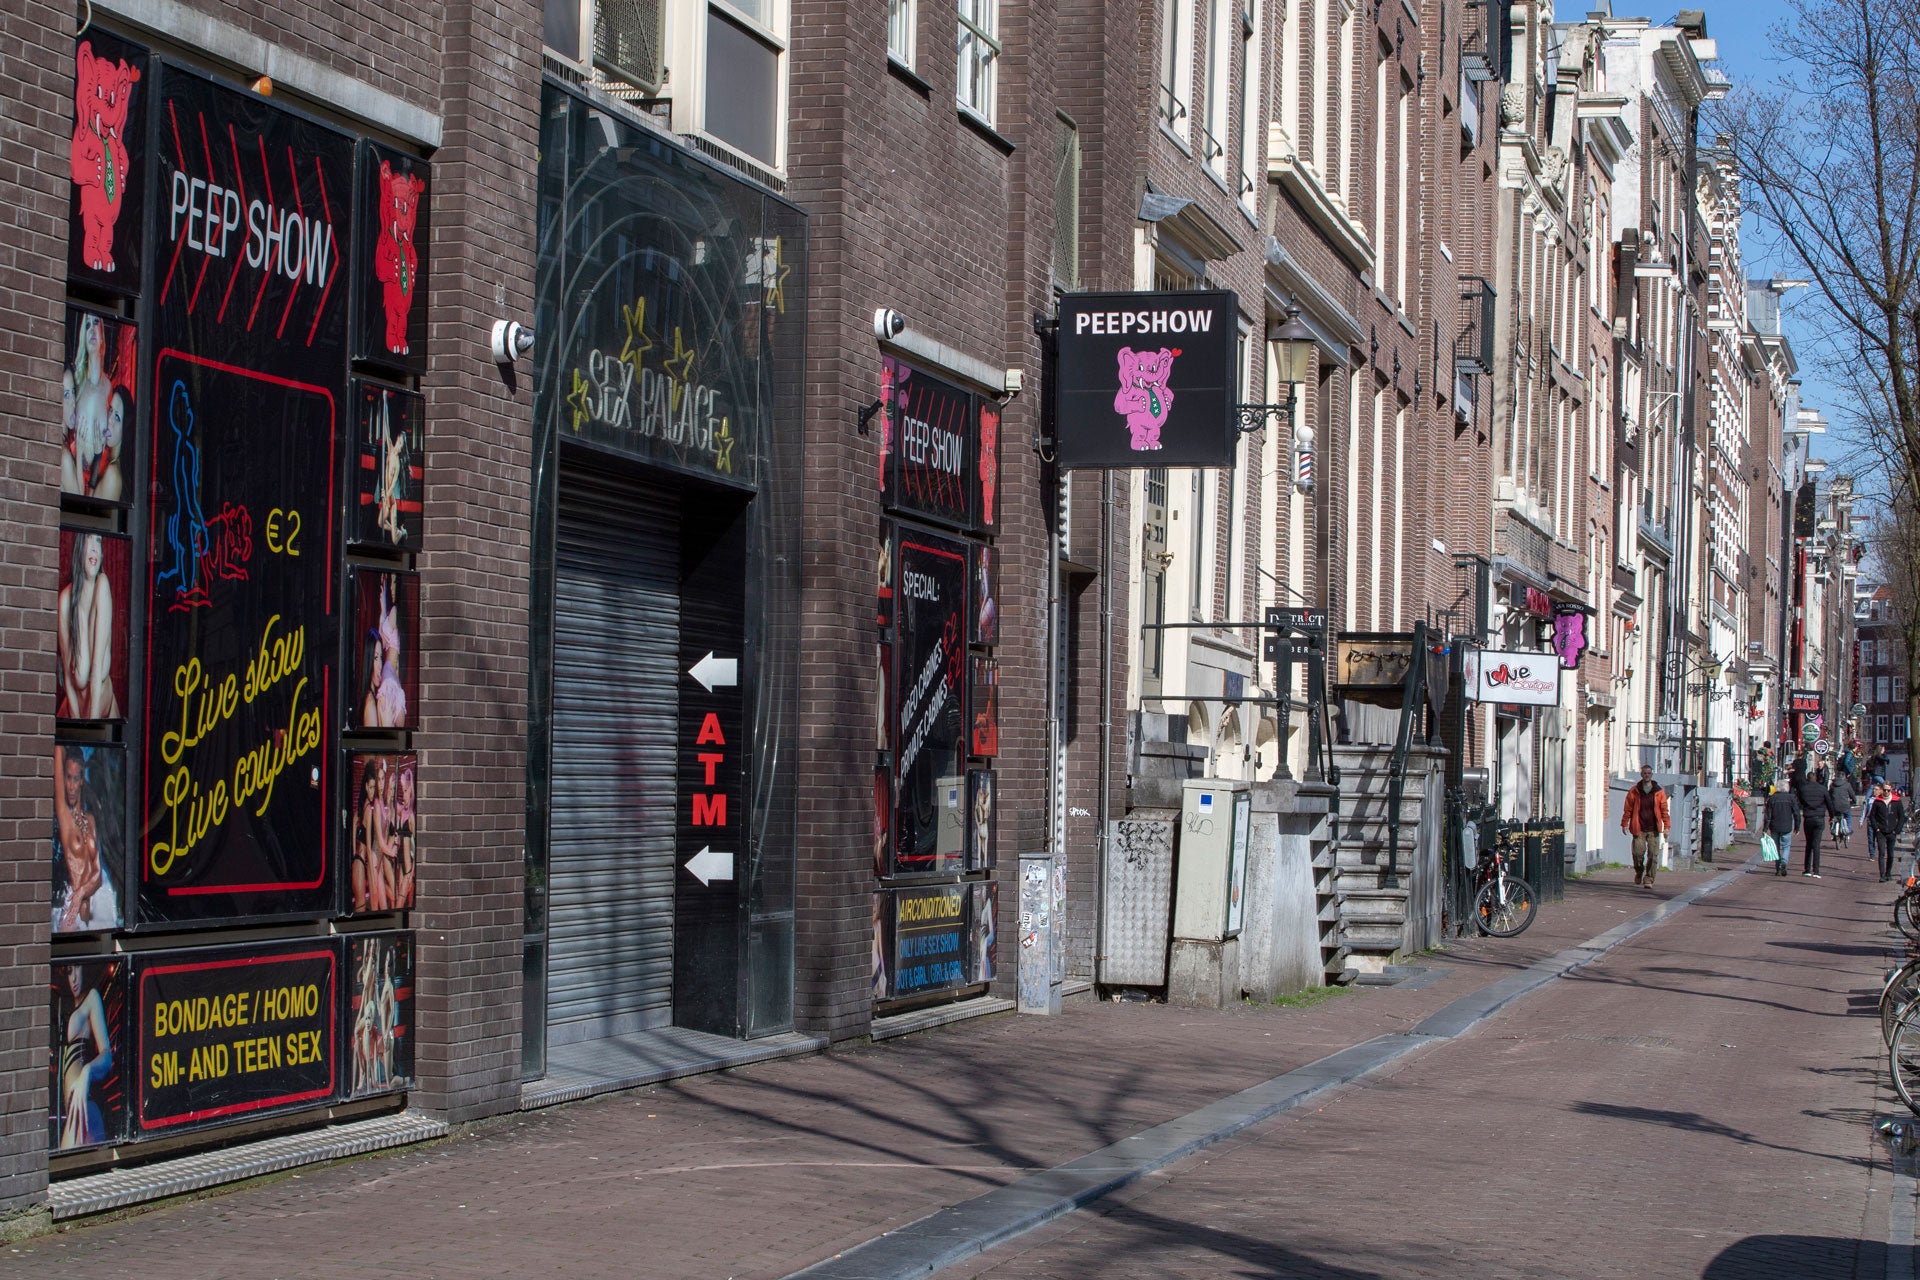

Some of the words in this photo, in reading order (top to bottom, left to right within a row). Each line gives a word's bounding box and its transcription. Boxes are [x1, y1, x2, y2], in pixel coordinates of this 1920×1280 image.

[170, 169, 240, 259] PEEP
[246, 199, 332, 289] SHOW
[1075, 310, 1213, 335] PEEPSHOW
[586, 348, 634, 430] SEX
[640, 367, 722, 454] PALACE
[903, 415, 929, 465] PEEP
[931, 426, 963, 477] SHOW
[266, 508, 300, 556] €2
[903, 570, 940, 601] SPECIAL:
[161, 657, 239, 765] Live
[243, 614, 304, 704] show
[901, 684, 918, 735] VIDEO
[918, 638, 943, 701] CABINES
[942, 612, 957, 655] €2
[900, 719, 923, 785] PRIVATE
[923, 674, 948, 737] CABINES
[947, 647, 961, 690] €2
[1793, 699, 1819, 711] BAR
[151, 765, 229, 876] Live
[234, 676, 321, 818] couples
[692, 712, 727, 826] ATM
[900, 895, 961, 922] AIRCONDITIONED
[900, 938, 914, 959] ONLY
[915, 935, 928, 957] LIVE
[928, 934, 941, 954] SEX
[940, 932, 960, 953] SHOW
[897, 968, 909, 990] BOY
[914, 965, 929, 986] GIRL
[931, 963, 944, 983] GIRL
[155, 992, 249, 1037] BONDAGE
[252, 990, 260, 1024] /
[263, 984, 318, 1022] HOMO
[151, 1050, 185, 1089] SM-
[189, 1043, 229, 1083] AND
[233, 1035, 281, 1074] TEEN
[286, 1030, 322, 1066] SEX
